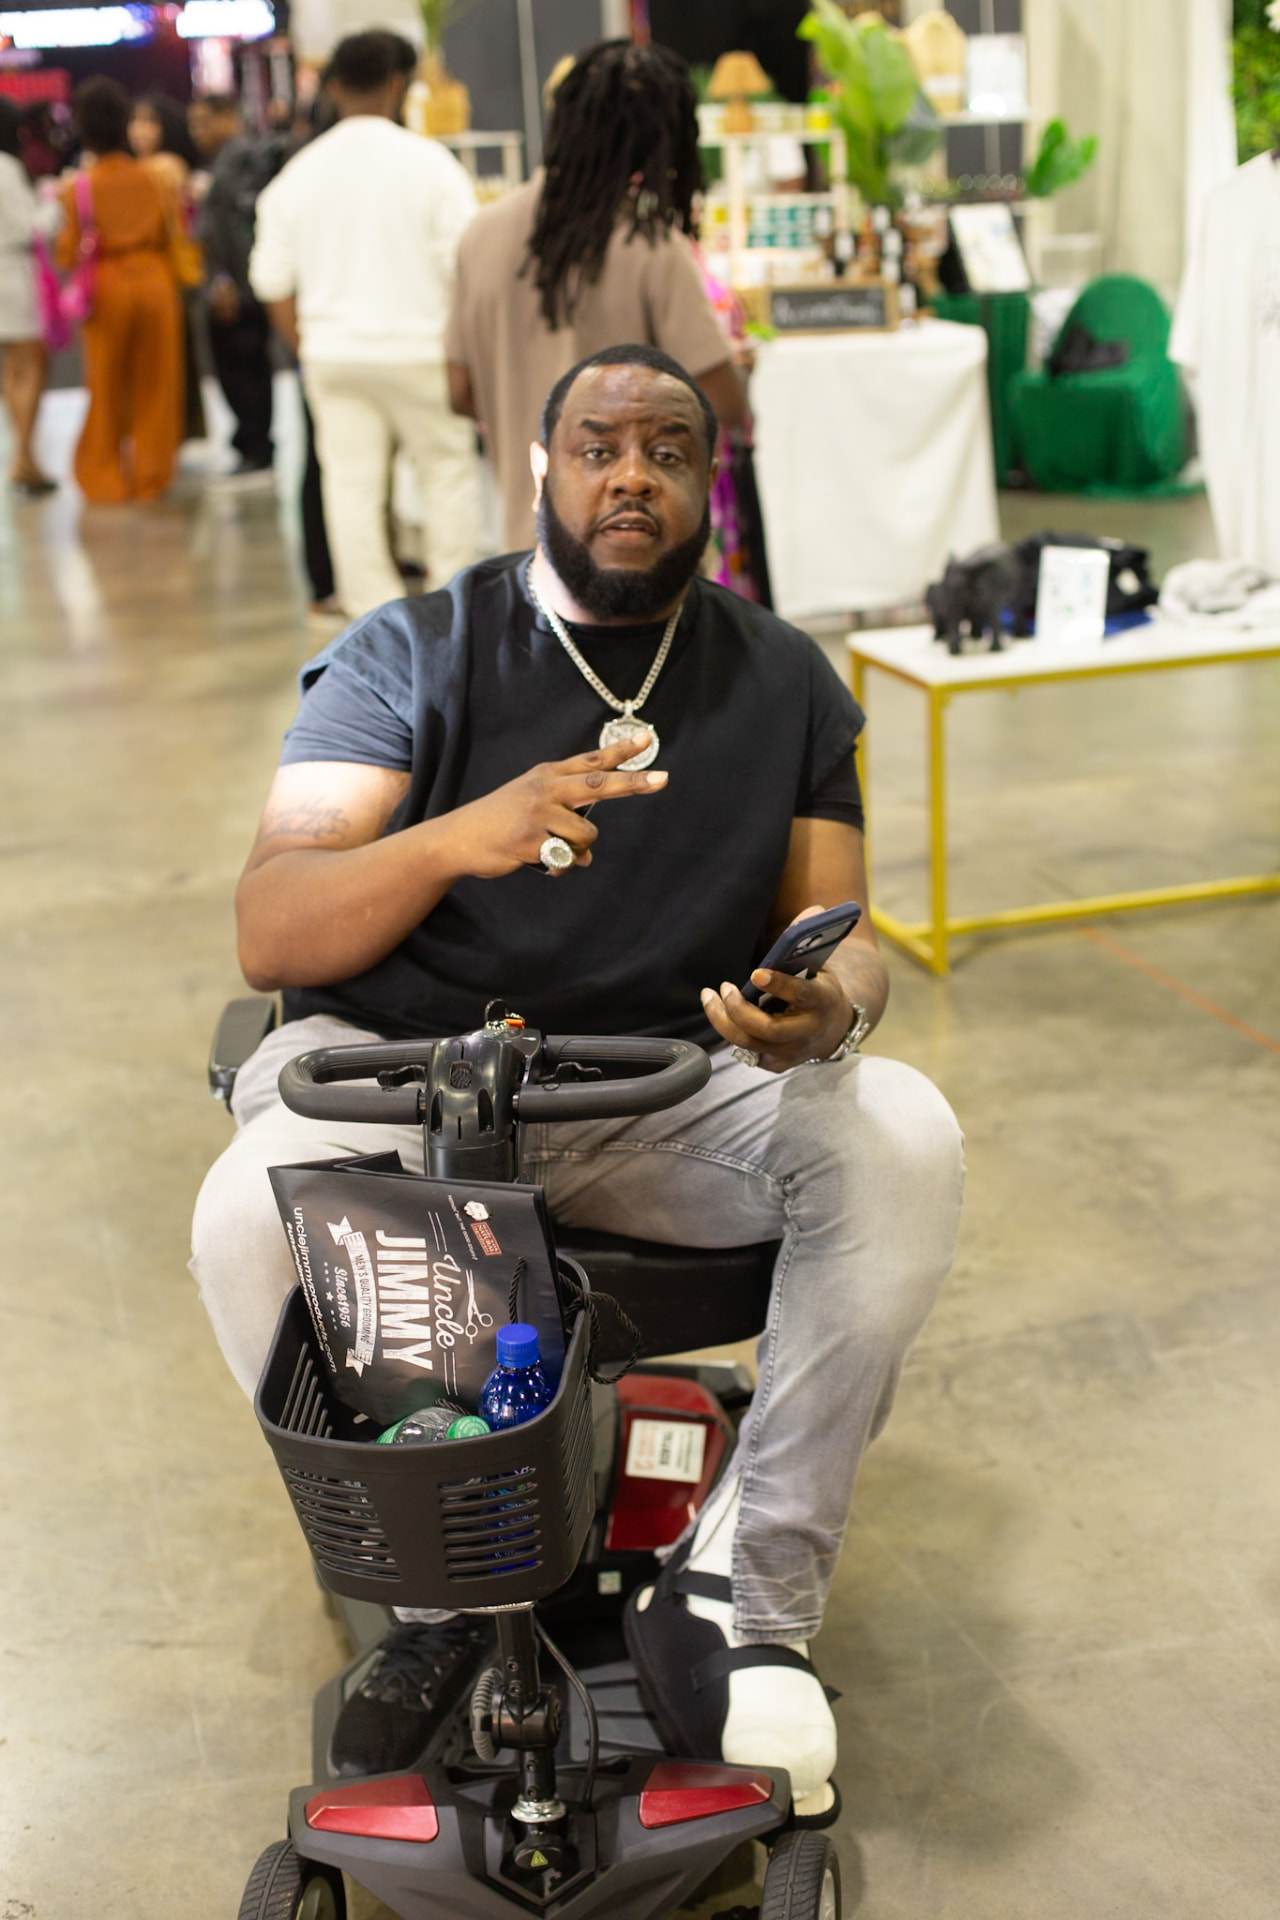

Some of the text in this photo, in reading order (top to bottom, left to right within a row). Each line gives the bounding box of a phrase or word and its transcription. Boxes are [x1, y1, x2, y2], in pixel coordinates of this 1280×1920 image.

[478, 1223, 496, 1253] NATURAL
[293, 1206, 337, 1374] unclejimmyproducts.com
[355, 1254, 373, 1343] MEN'S QUALITY GROOMING
[375, 1229, 433, 1371] JIMMY
[432, 1253, 465, 1350] Uncle
